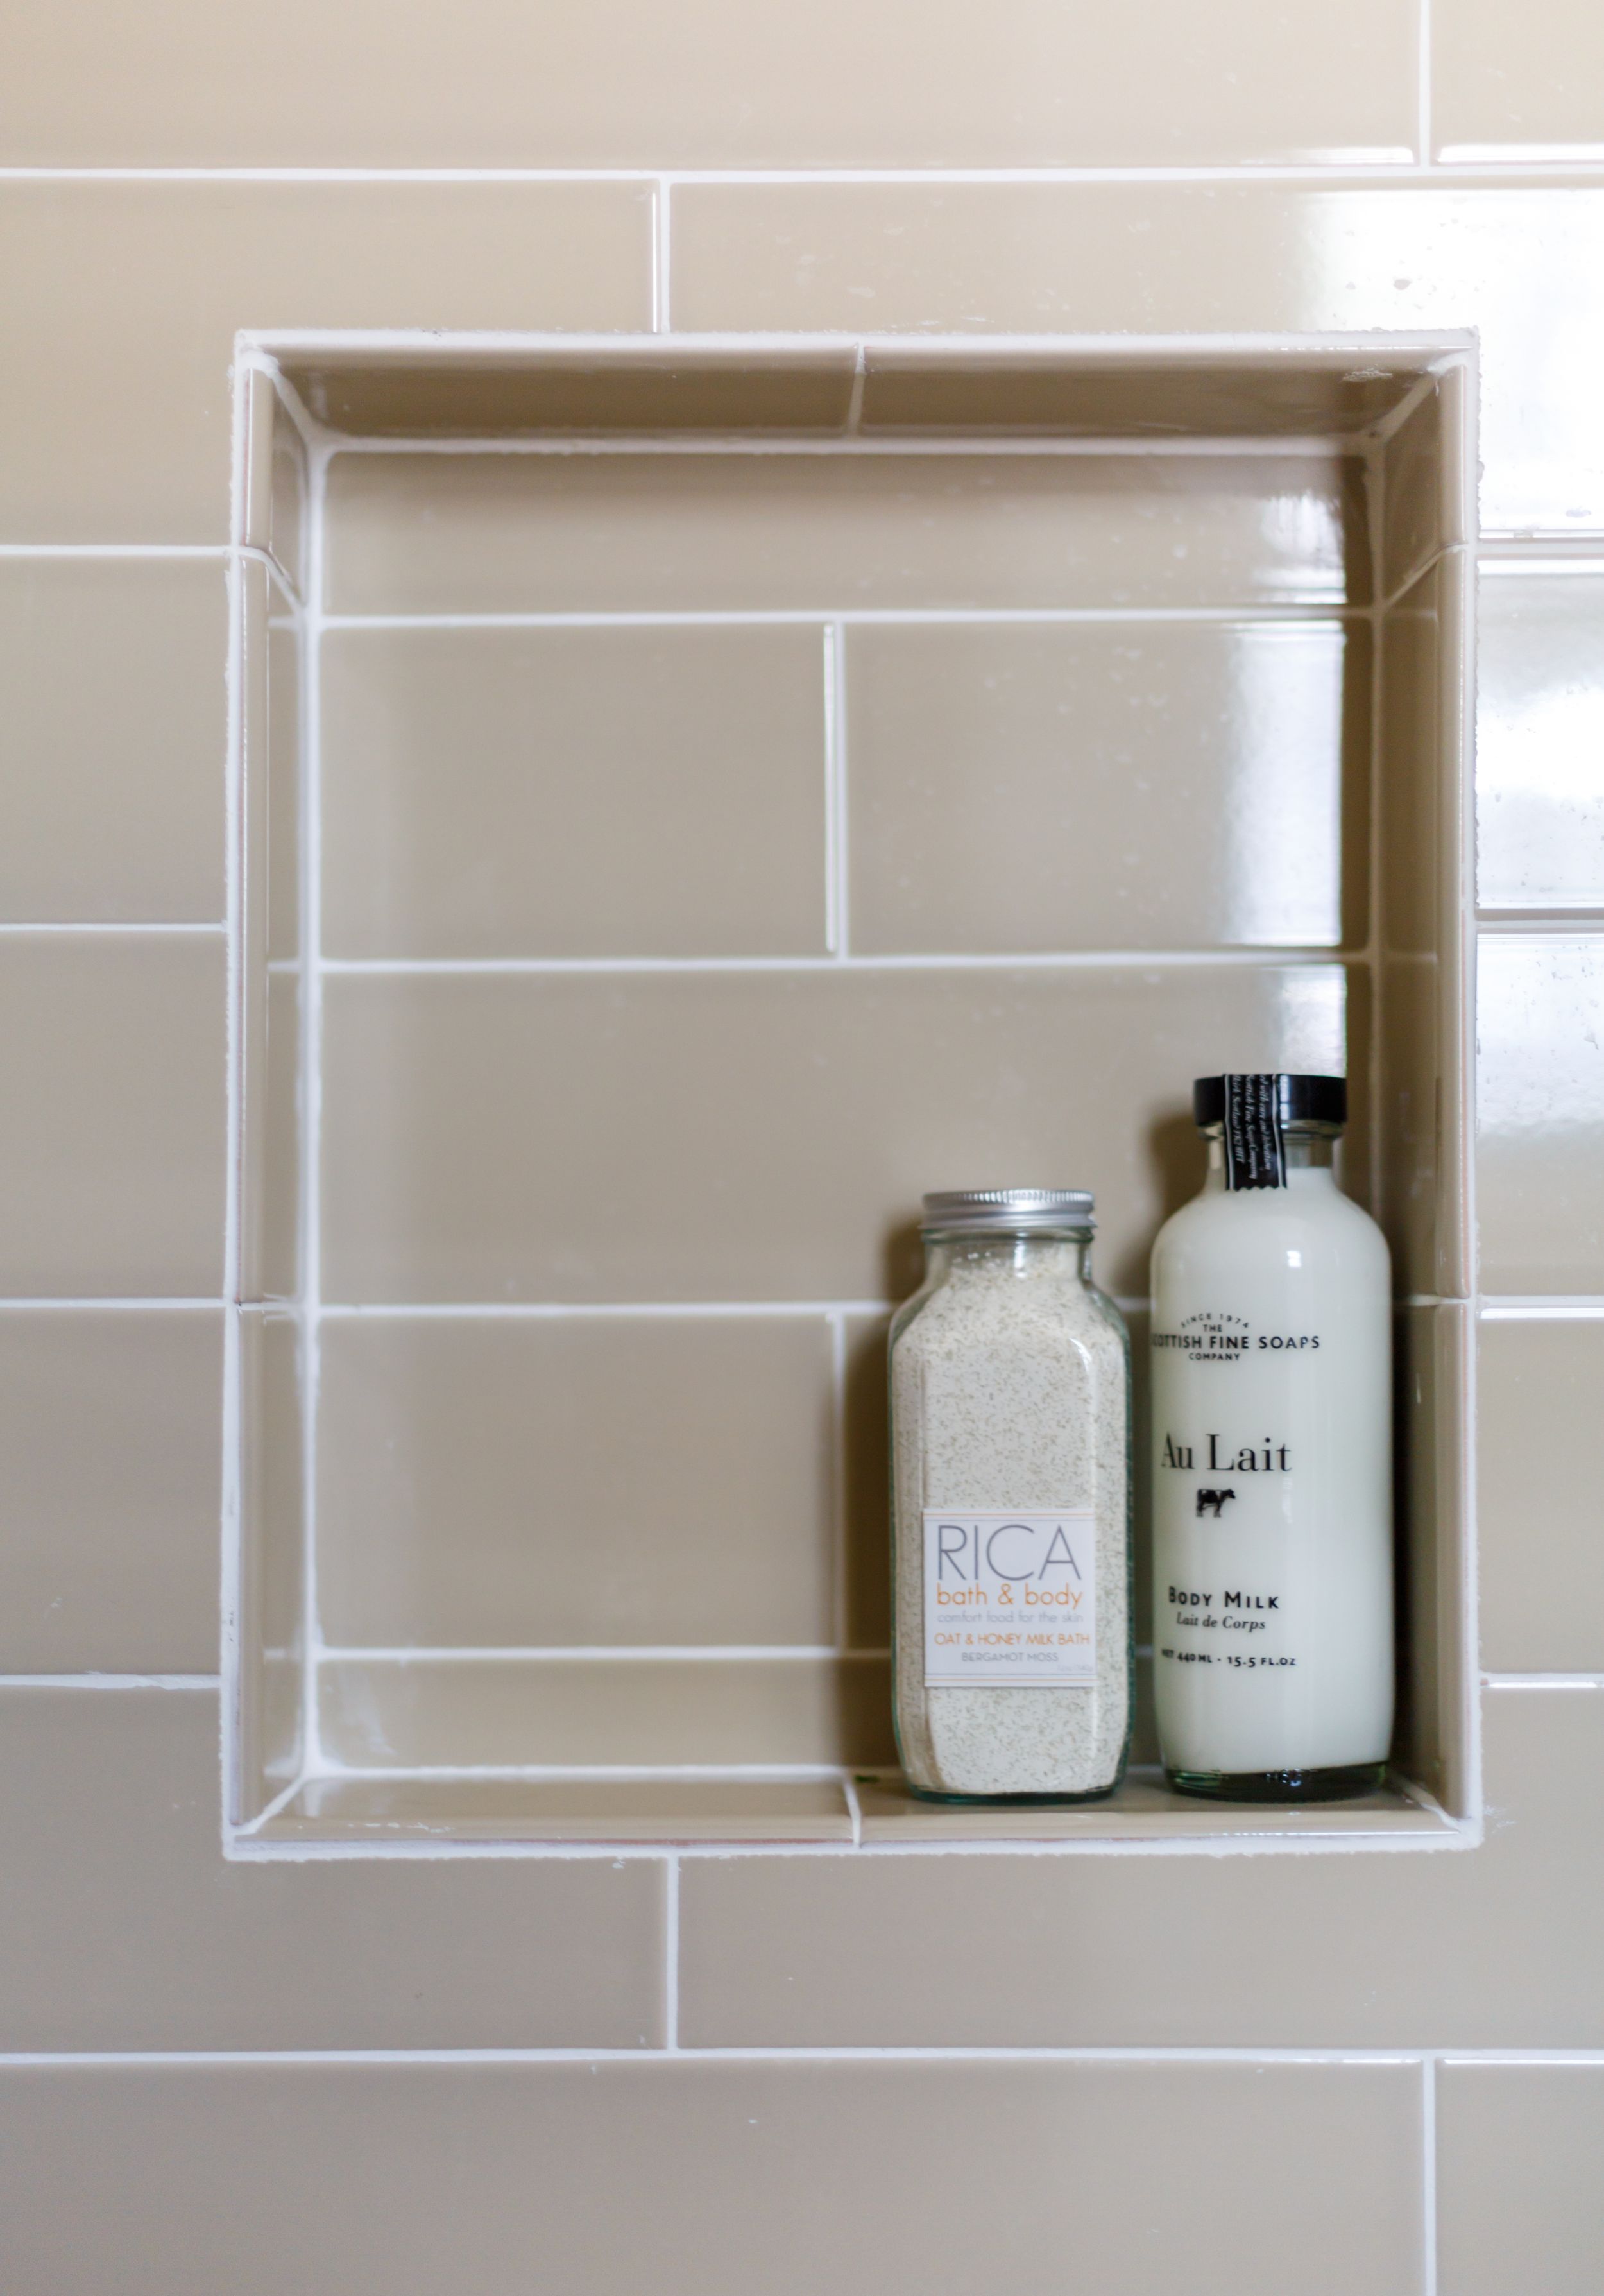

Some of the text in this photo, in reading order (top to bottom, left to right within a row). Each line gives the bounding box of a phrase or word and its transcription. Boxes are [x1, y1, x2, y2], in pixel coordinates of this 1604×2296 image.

[1181, 1313, 1249, 1328] SINCE 1974
[1203, 1324, 1222, 1332] THE
[1210, 1335, 1249, 1349] FINE
[1258, 1335, 1320, 1349] SOAPS
[1189, 1352, 1240, 1361] COMPANY
[1161, 1431, 1292, 1471] Au Lait
[938, 1524, 1082, 1581] RICA
[937, 1582, 1083, 1610] bath & body
[1168, 1586, 1279, 1609] BODY MILK
[937, 1610, 1084, 1623] comfort food for the skin
[1177, 1611, 1266, 1632] Lait de Corps
[934, 1633, 1089, 1645] OAT & HONEY MILK BATH
[962, 1652, 1058, 1662] BERGAMOT MOSS
